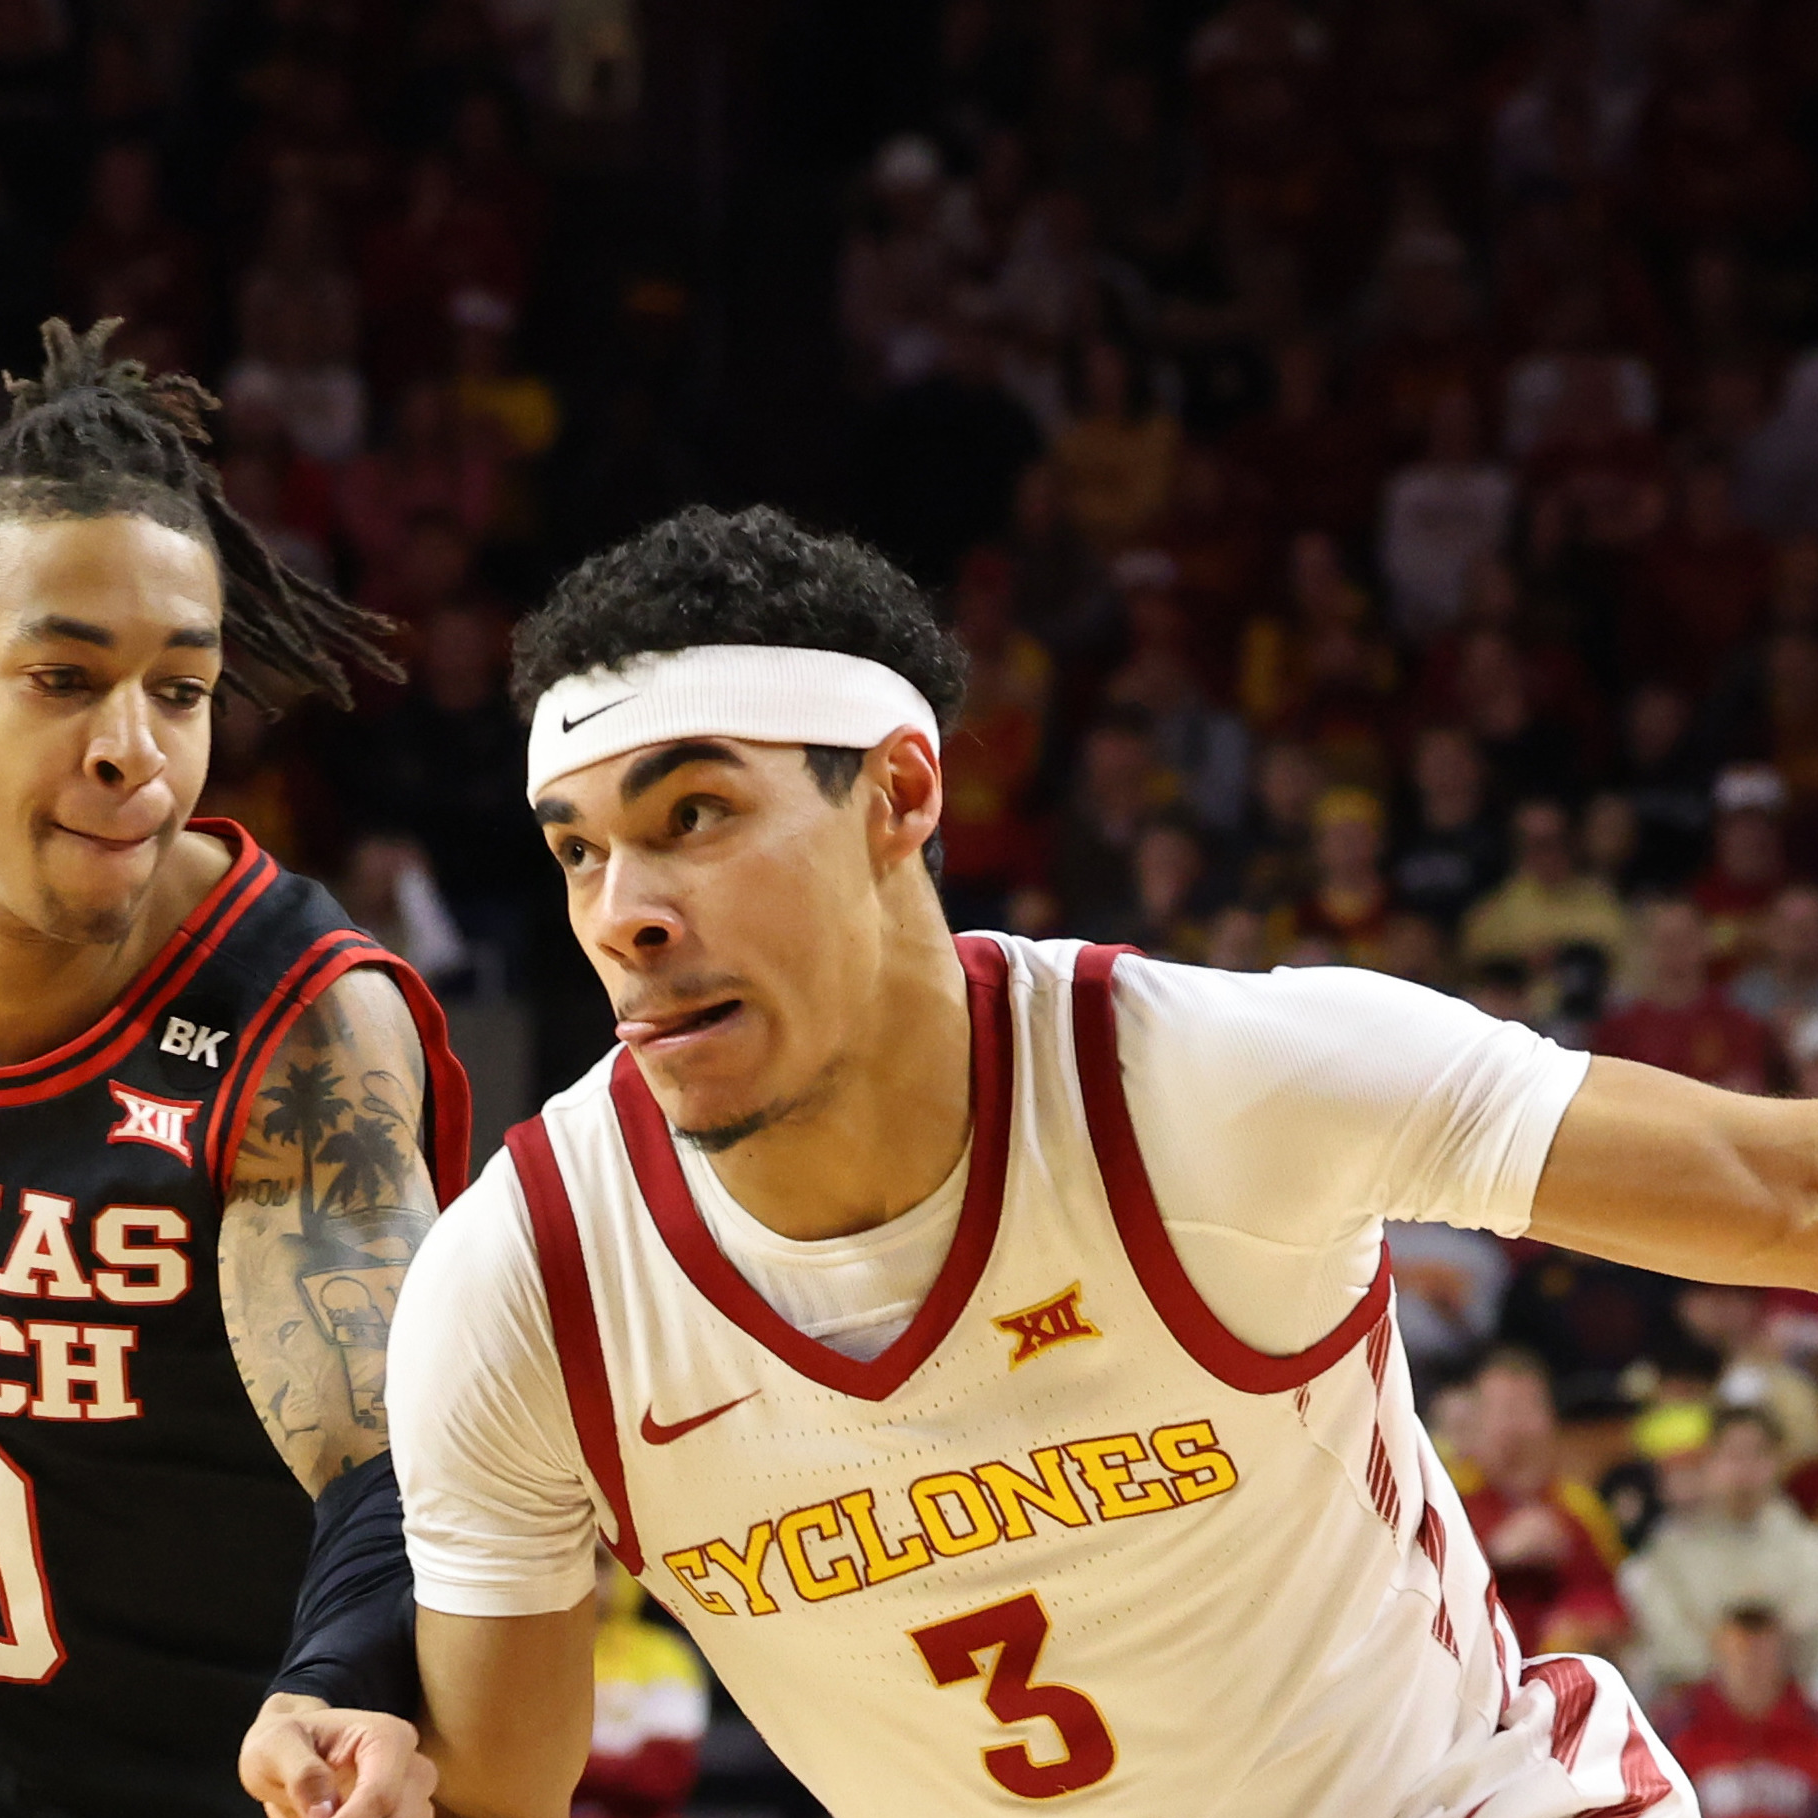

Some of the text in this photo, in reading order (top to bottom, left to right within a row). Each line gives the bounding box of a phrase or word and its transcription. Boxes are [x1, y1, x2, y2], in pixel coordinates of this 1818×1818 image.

[159, 1016, 230, 1068] BK
[113, 1090, 198, 1158] XII
[663, 1419, 1238, 1617] CYCLONES
[905, 1589, 1118, 1800] 3
